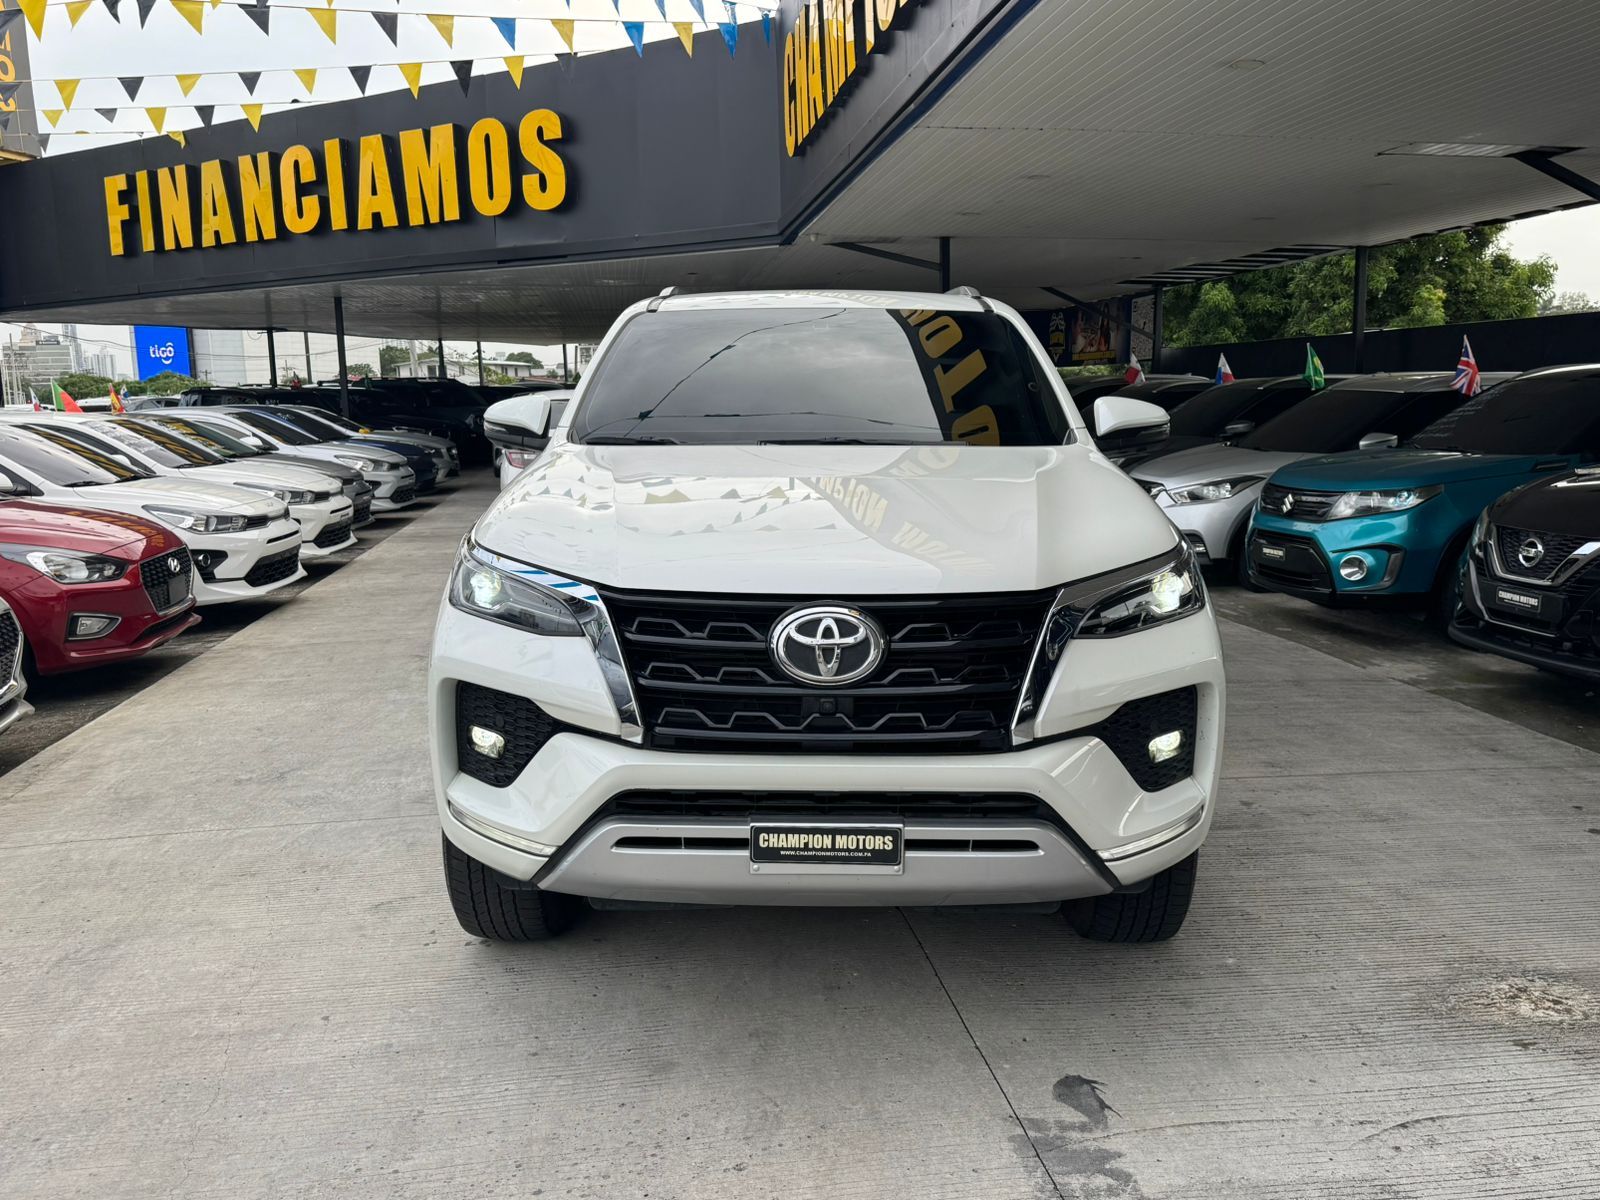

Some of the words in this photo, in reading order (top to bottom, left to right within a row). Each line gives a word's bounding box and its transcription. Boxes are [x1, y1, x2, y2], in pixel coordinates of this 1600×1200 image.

[104, 109, 567, 257] FINANCIAMOS
[758, 832, 832, 849] CHAMPION
[835, 834, 894, 851] MOTORS
